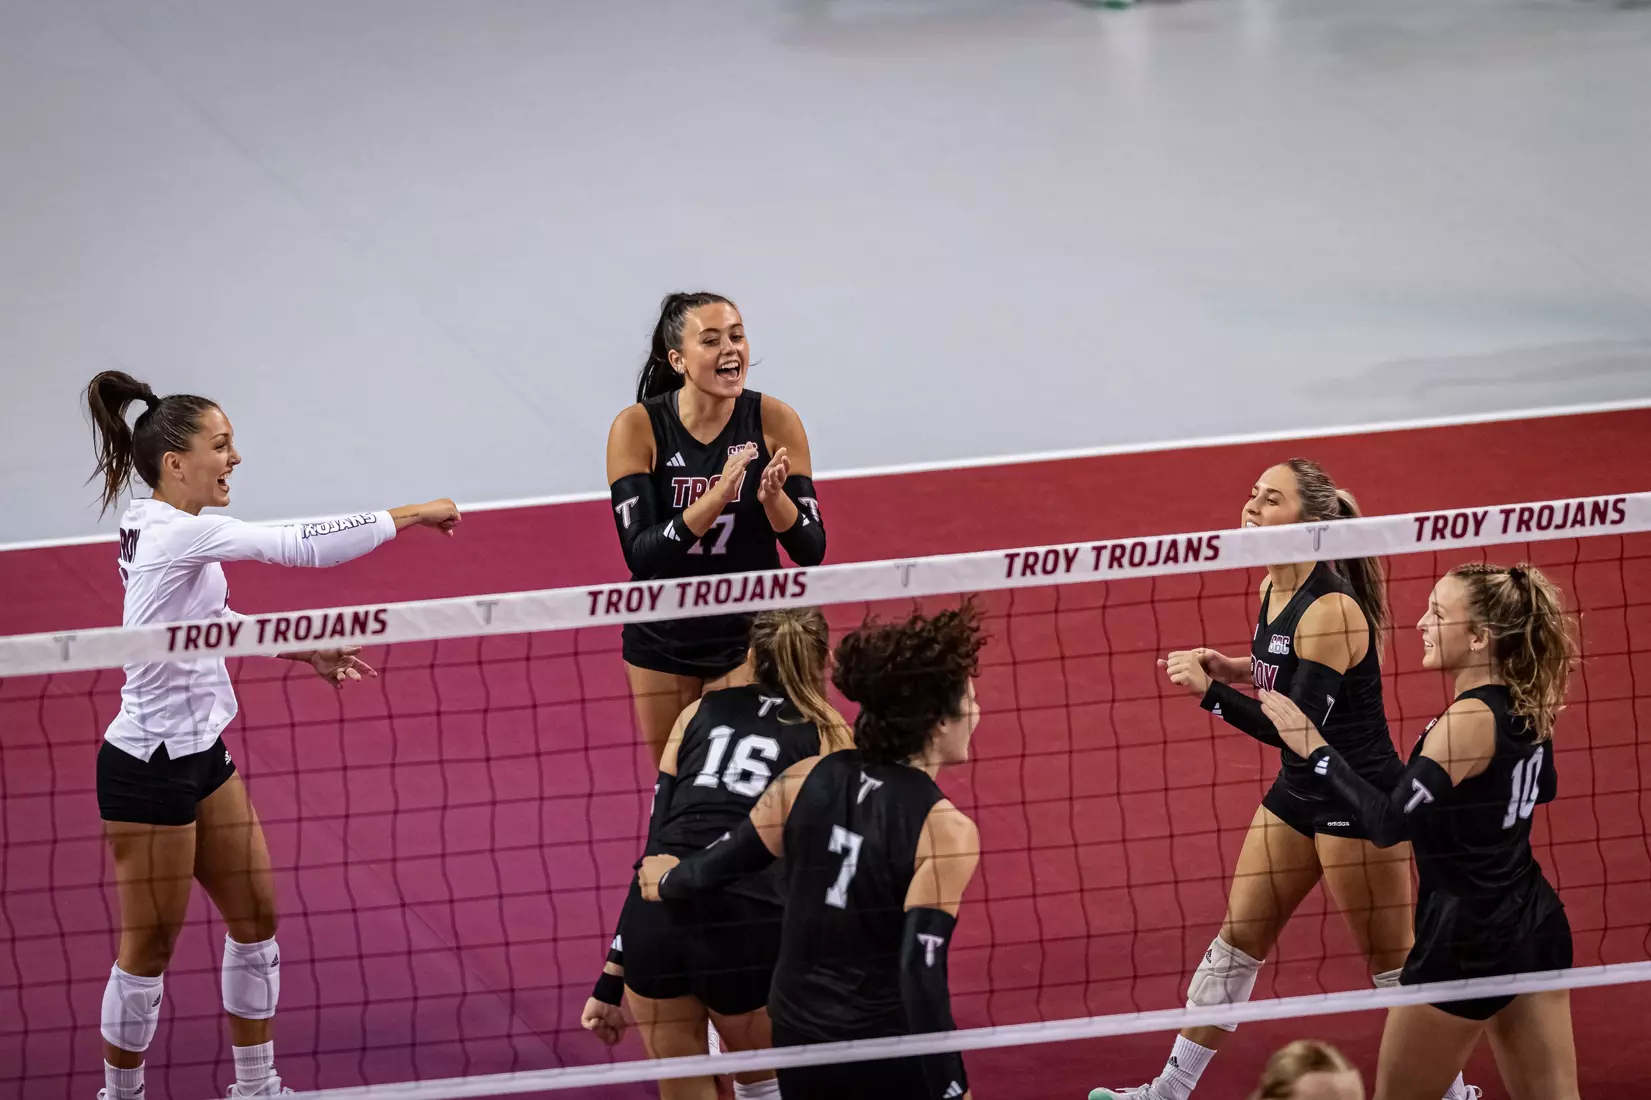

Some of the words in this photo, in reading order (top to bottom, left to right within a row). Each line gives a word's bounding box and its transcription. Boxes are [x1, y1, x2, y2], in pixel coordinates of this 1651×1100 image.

[671, 471, 747, 508] TR
[1413, 510, 1490, 543] TROY
[1499, 497, 1627, 535] TROJANS
[119, 527, 141, 564] ROY
[1004, 547, 1080, 579] TROY
[1091, 534, 1221, 572] TROJANS
[587, 584, 665, 617] TROY
[675, 571, 807, 609] TROJANS
[166, 620, 244, 653] TROY
[255, 608, 388, 645] TROJANS
[693, 724, 780, 798] 16
[1502, 745, 1544, 829] 10
[825, 824, 864, 909] 7
